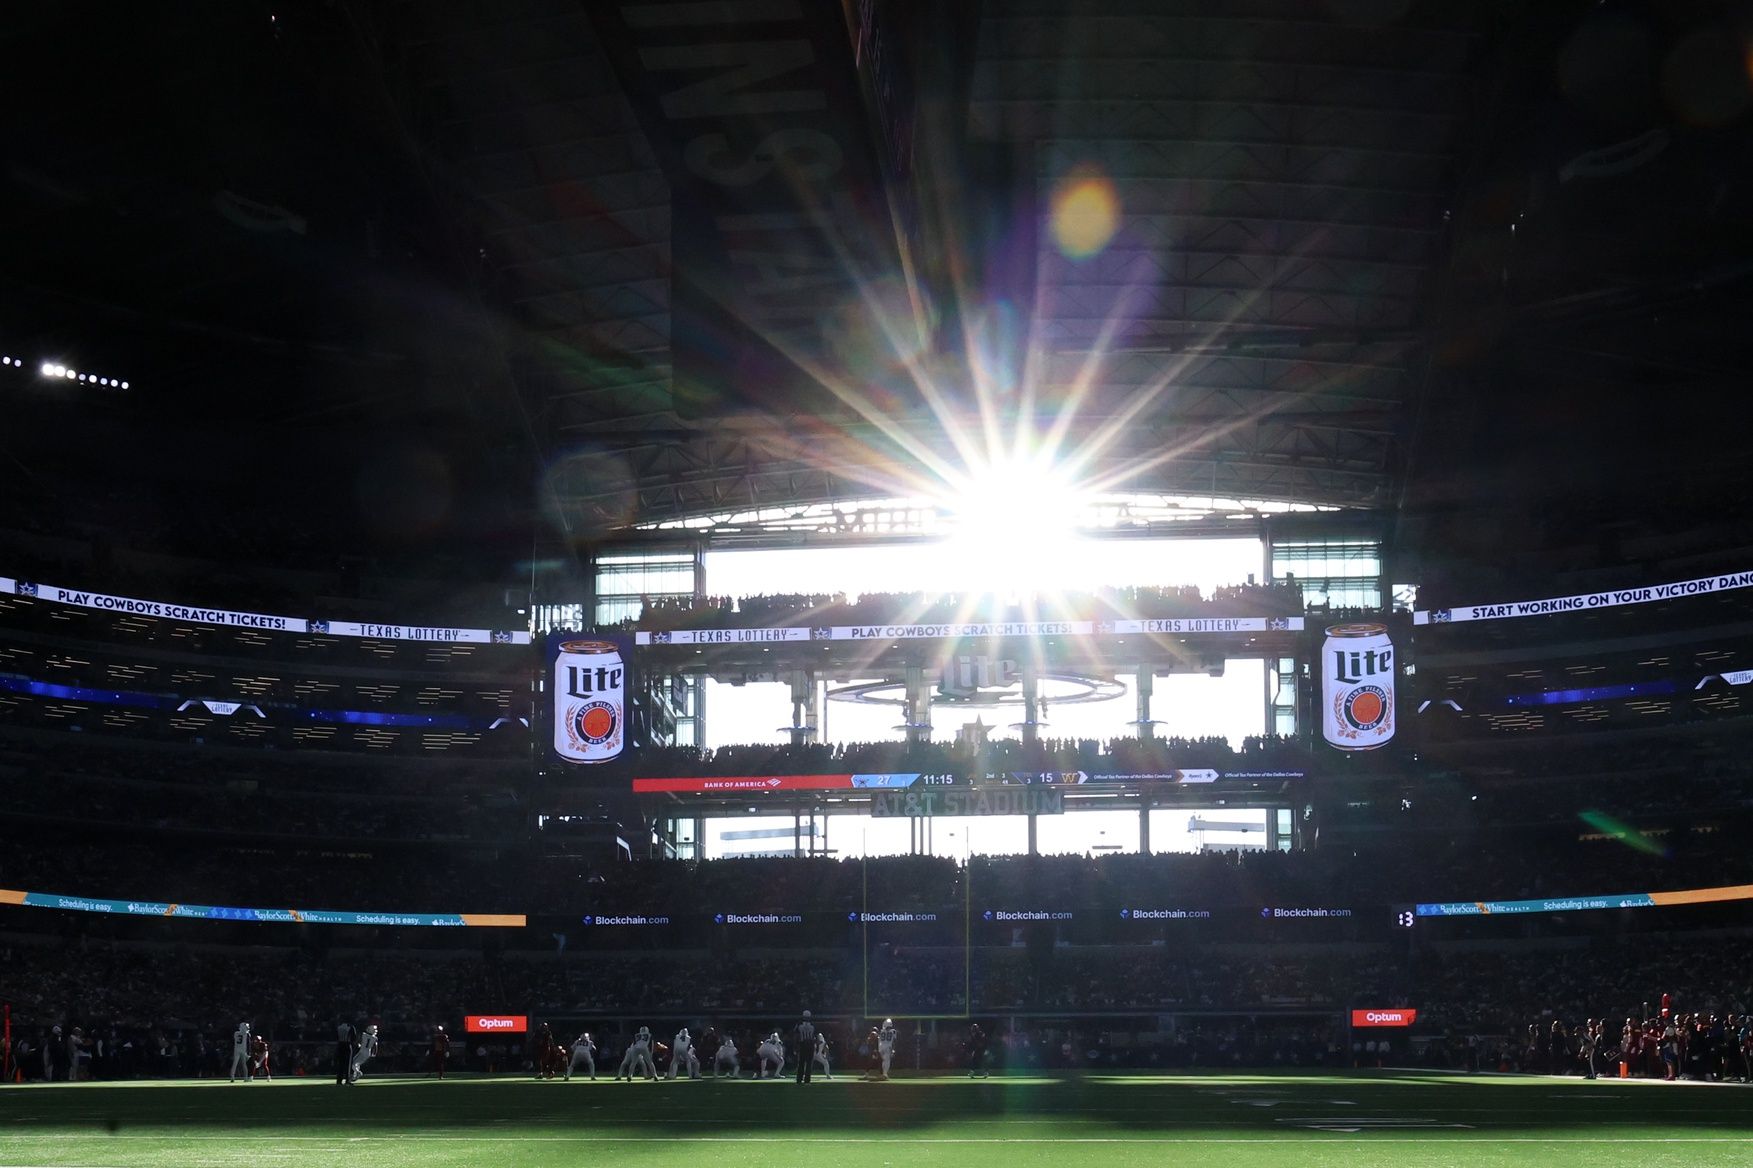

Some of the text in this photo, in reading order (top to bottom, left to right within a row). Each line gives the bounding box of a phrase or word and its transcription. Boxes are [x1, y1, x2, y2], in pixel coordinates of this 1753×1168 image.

[1472, 605, 1513, 618] START
[1517, 597, 1584, 614] WORKING
[1587, 594, 1609, 606] ON
[1612, 589, 1651, 603] YOUR
[1655, 578, 1715, 598] VICTORY
[58, 590, 286, 629] PLAY COWBOYS SCRATCH TICKETS!
[852, 623, 1072, 638] PLAY COWBOYS SCRATCH TICKETS!
[1141, 619, 1239, 632] TEXAS LOTTERY
[360, 624, 459, 641] TEXAS LOTTERY
[692, 629, 787, 643] TEXAS LOTTERY
[1333, 650, 1392, 684] Lite
[566, 665, 622, 699] Lite
[939, 655, 1018, 697] Lite
[878, 775, 891, 785] 27
[923, 774, 953, 785] 11:15
[1039, 773, 1053, 783] 15
[873, 791, 1063, 816] AT&T STADIUM
[59, 898, 90, 911] Scheduling
[95, 903, 113, 913] easy.
[1544, 900, 1608, 911] Scheduling is easy.
[860, 912, 936, 922] Blockchain.com
[996, 911, 1073, 920] Blockchain.com
[1133, 909, 1209, 918] Blockchain.com
[1274, 907, 1352, 917] Blockchain.com
[356, 914, 395, 925] Scheduling
[402, 917, 421, 925] easy.
[595, 916, 669, 925] Blockchain.com
[727, 914, 802, 924] Blockchain.com
[478, 1018, 513, 1030] Optum
[1366, 1012, 1402, 1024] Optum
